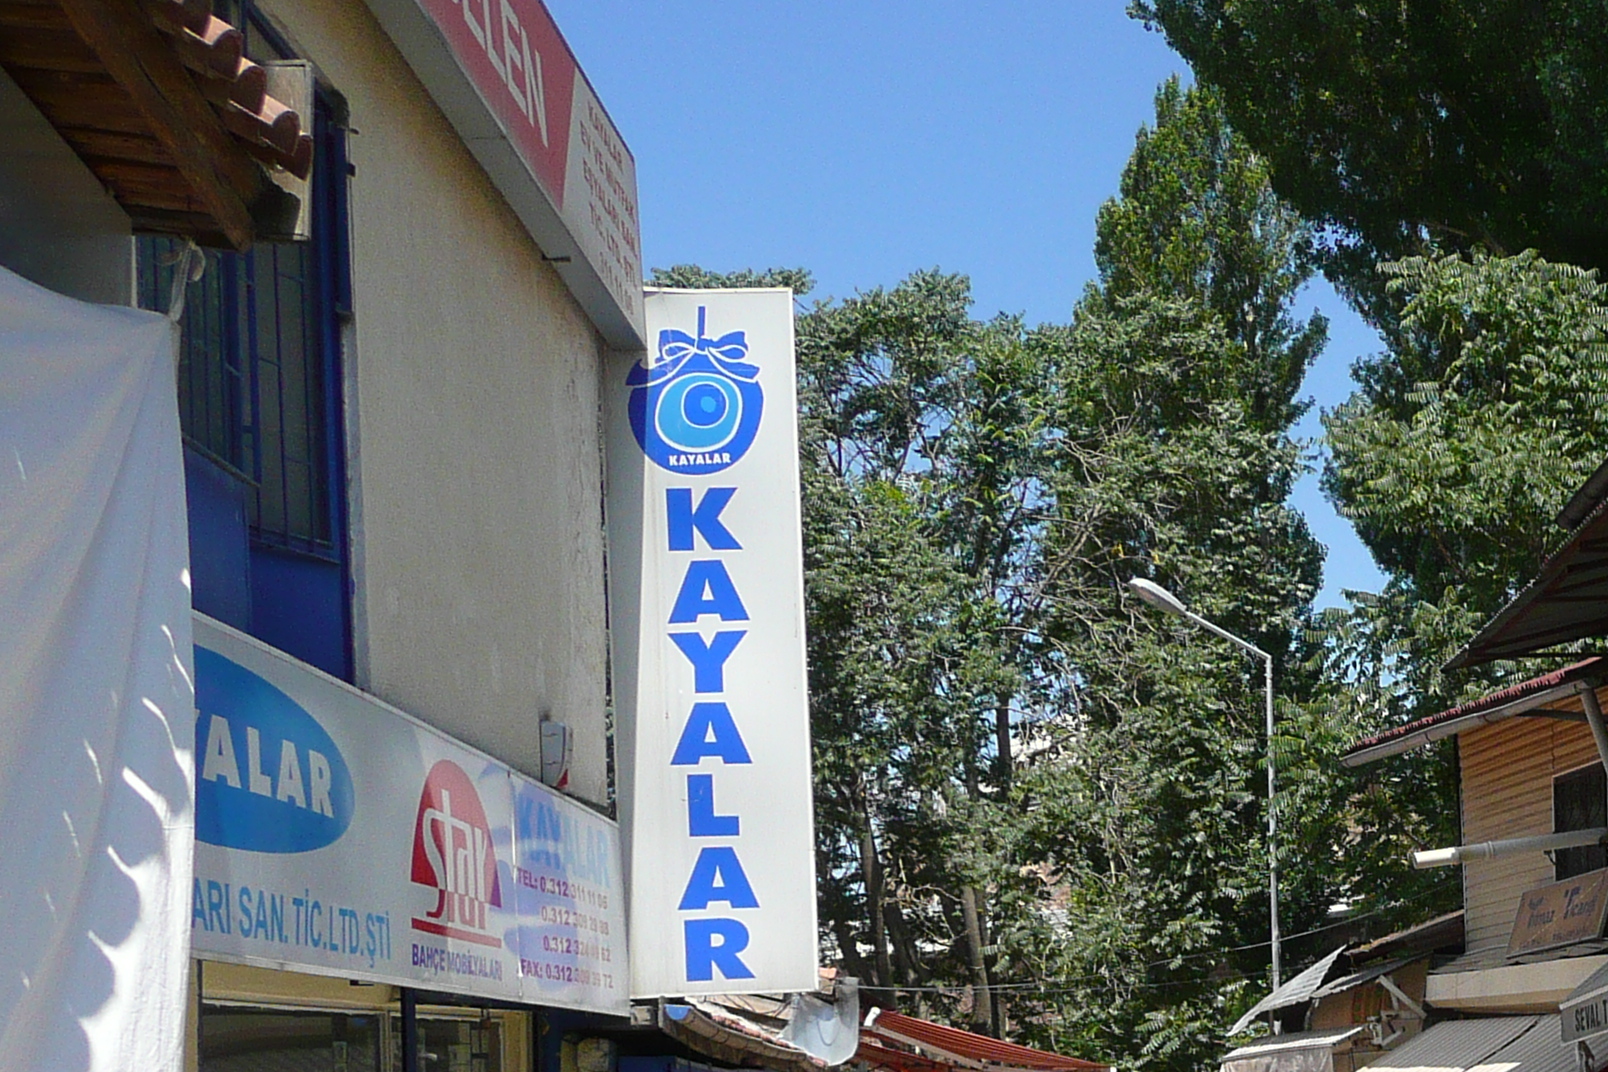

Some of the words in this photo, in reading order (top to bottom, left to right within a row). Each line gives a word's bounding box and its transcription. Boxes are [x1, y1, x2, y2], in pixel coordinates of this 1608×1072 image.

[668, 453, 732, 467] KAYALAR
[665, 486, 761, 982] KAYALAR
[194, 707, 335, 819] ALAR
[517, 867, 538, 890] TEL:
[539, 875, 569, 898] 0.312
[540, 905, 570, 927] 0.312
[542, 934, 572, 955] 0.312
[411, 943, 446, 976] BAHÇE
[446, 949, 503, 982] MOBİLYALARI
[520, 957, 543, 979] FAX:
[545, 962, 573, 983] 0.312
[1574, 1002, 1602, 1032] SEVAL
